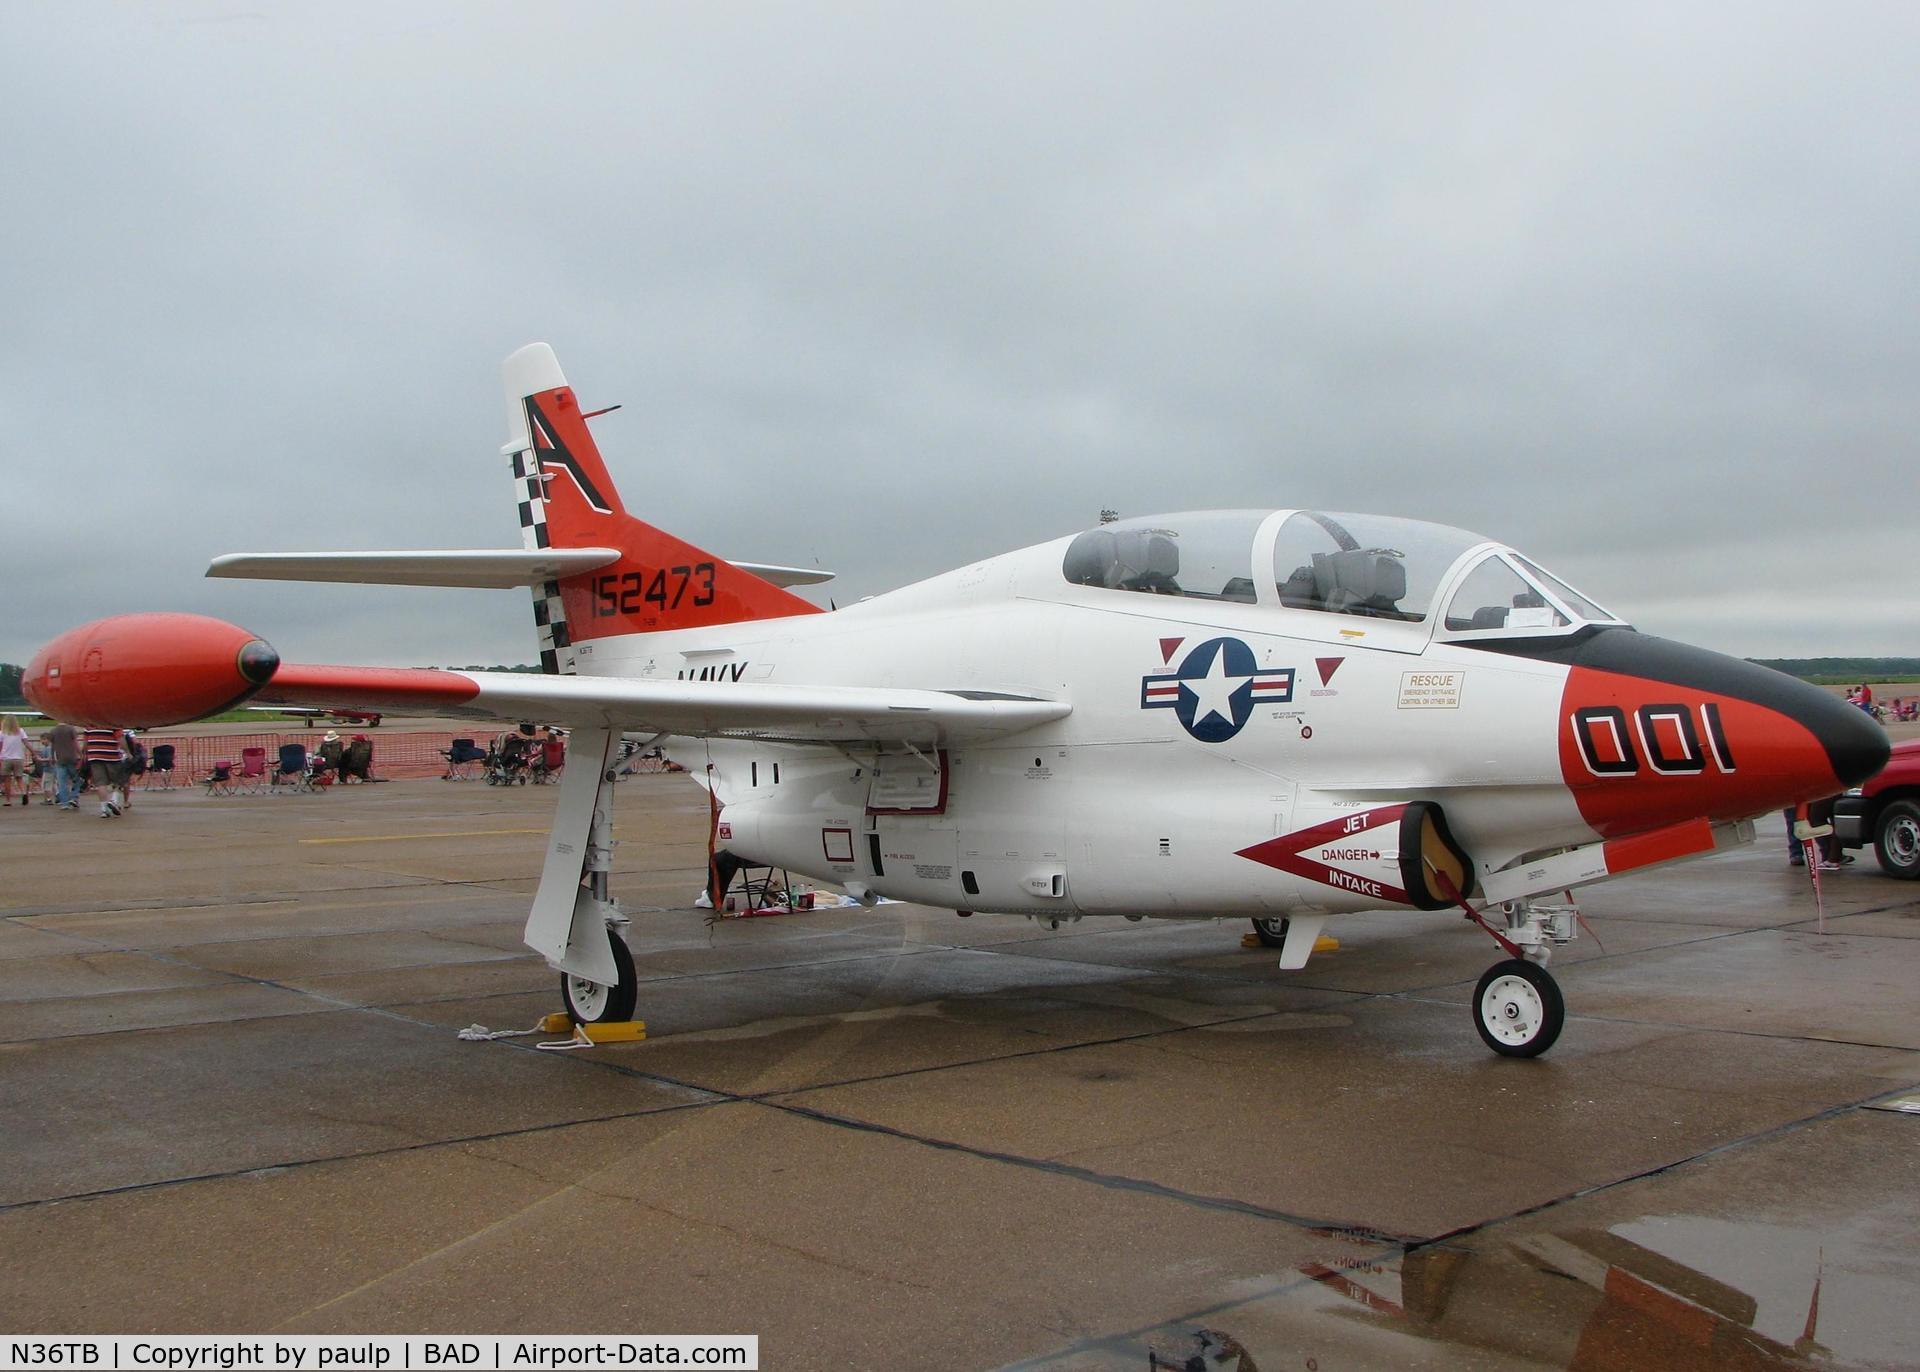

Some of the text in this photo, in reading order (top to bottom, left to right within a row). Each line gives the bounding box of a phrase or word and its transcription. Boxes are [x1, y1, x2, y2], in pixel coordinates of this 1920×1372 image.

[522, 394, 613, 515] A
[592, 562, 716, 619] 152473
[1410, 675, 1454, 686] RESCUE
[1569, 703, 1737, 777] 001
[1343, 813, 1370, 833] JET
[1322, 849, 1369, 861] DANGER
[1329, 870, 1382, 897] INTAKE
